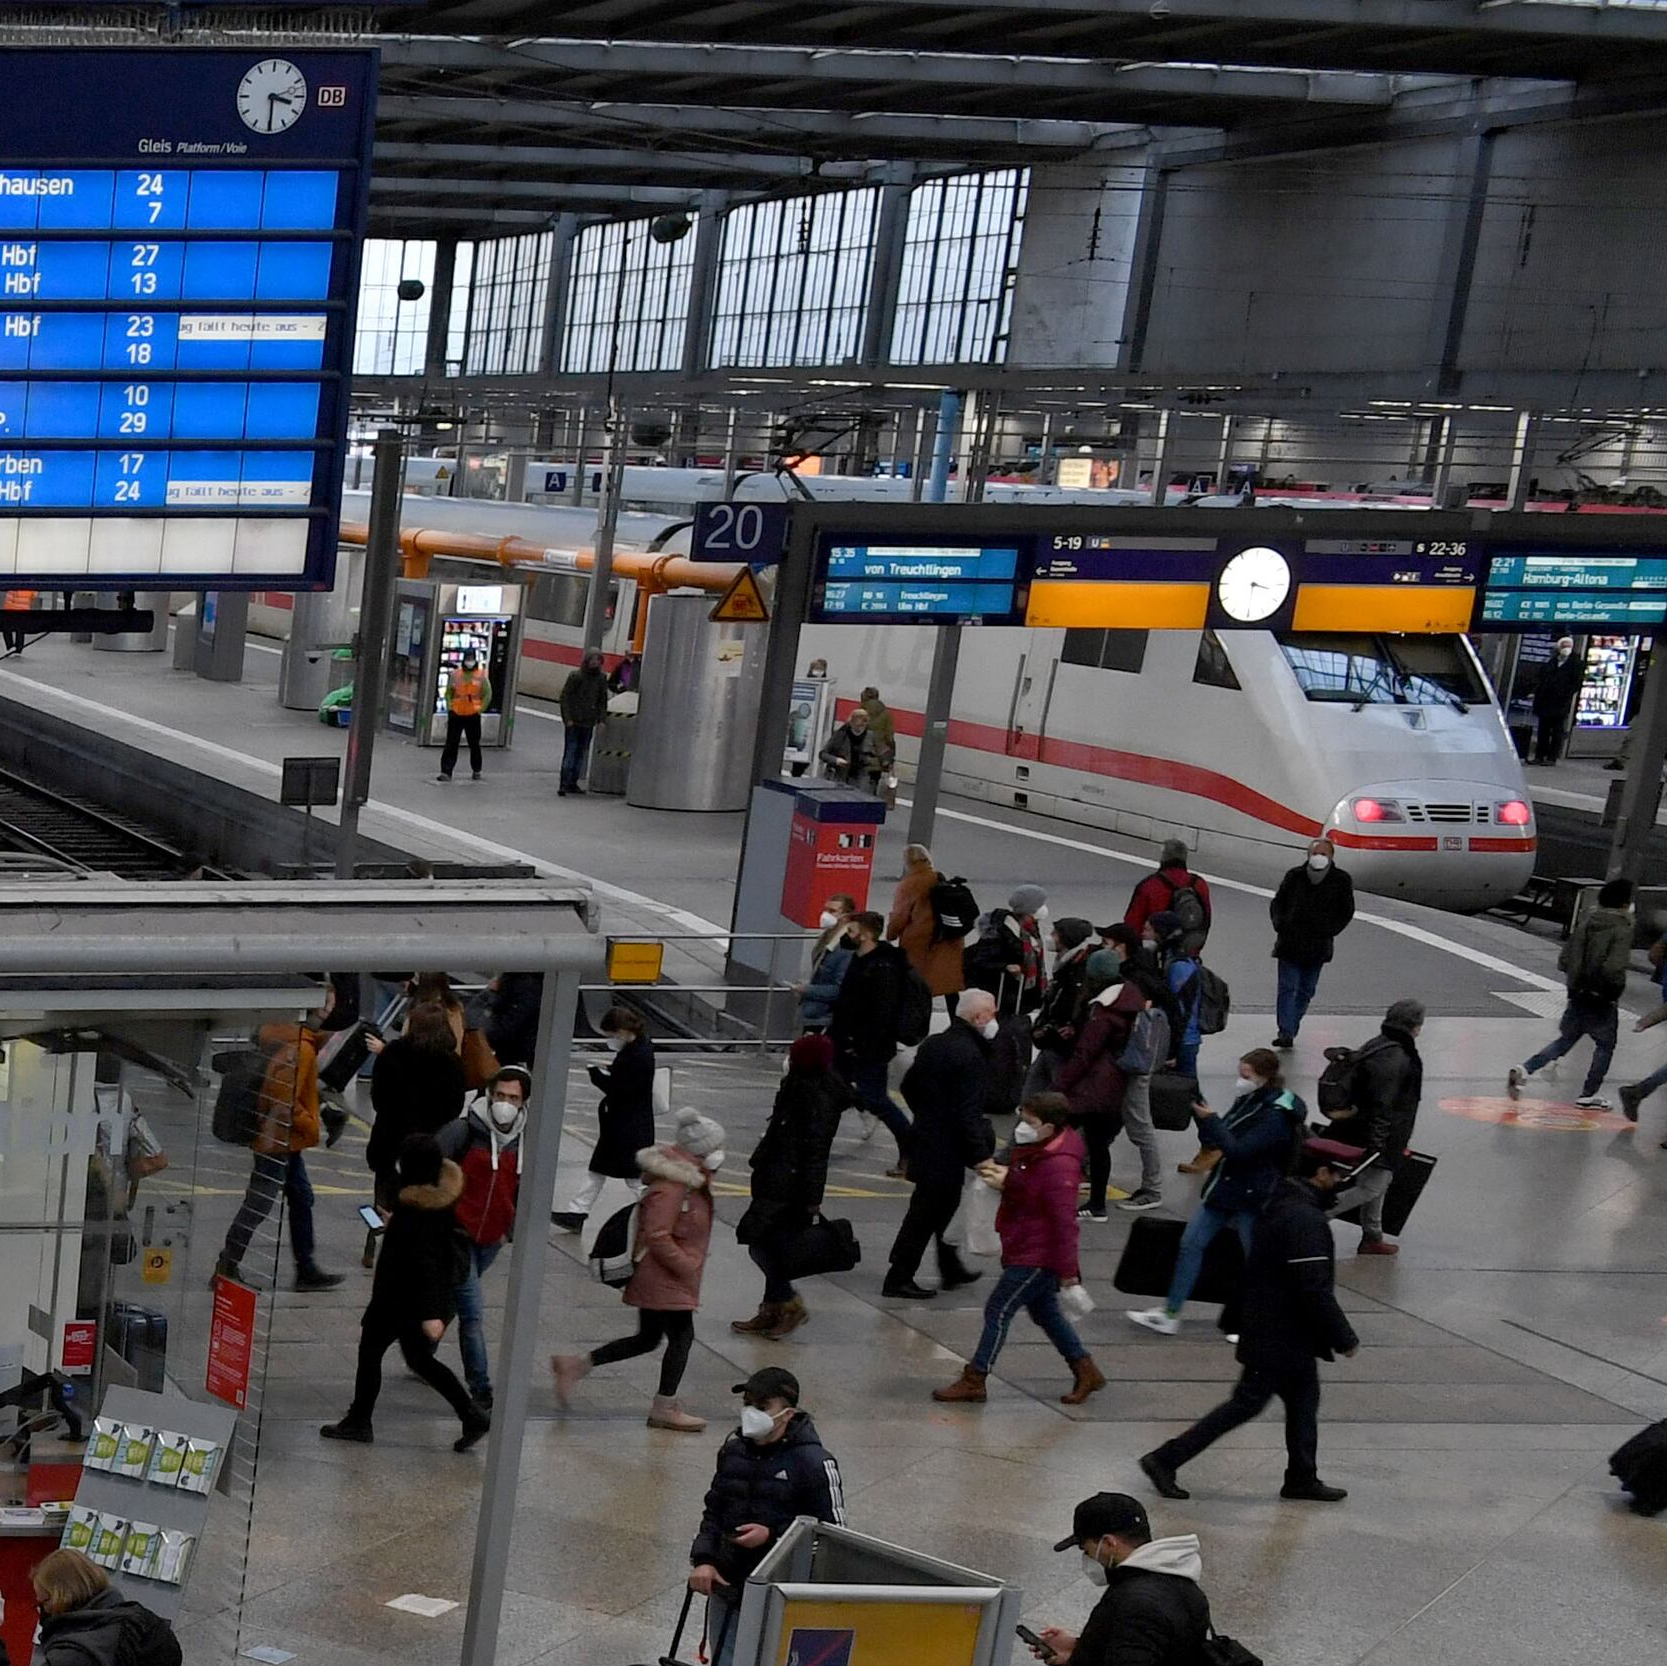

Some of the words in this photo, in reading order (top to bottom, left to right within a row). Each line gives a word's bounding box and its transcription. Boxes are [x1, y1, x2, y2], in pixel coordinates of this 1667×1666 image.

[321, 90, 343, 103] DB
[138, 138, 171, 154] Gleis
[177, 142, 247, 154] Platform/Voie
[136, 174, 163, 195] 24
[148, 203, 161, 223] 7
[2, 245, 38, 266] Hbf
[131, 245, 159, 266] 27
[5, 273, 40, 294] Hbf
[131, 273, 157, 293] 13
[5, 316, 40, 337] Hbf
[127, 316, 154, 336] 23
[127, 344, 151, 364] 18
[124, 386, 148, 406] 10
[120, 413, 146, 433] 29
[120, 454, 143, 474] 17
[115, 481, 140, 502] 24
[705, 505, 763, 550] 20
[1053, 536, 1082, 550] 5-19
[1429, 542, 1466, 556] 22-36
[865, 565, 884, 574] von
[890, 563, 961, 577] Treuchtlingen
[1523, 574, 1608, 587] Hamburg-Altona
[817, 853, 864, 862] Fahrkarten
